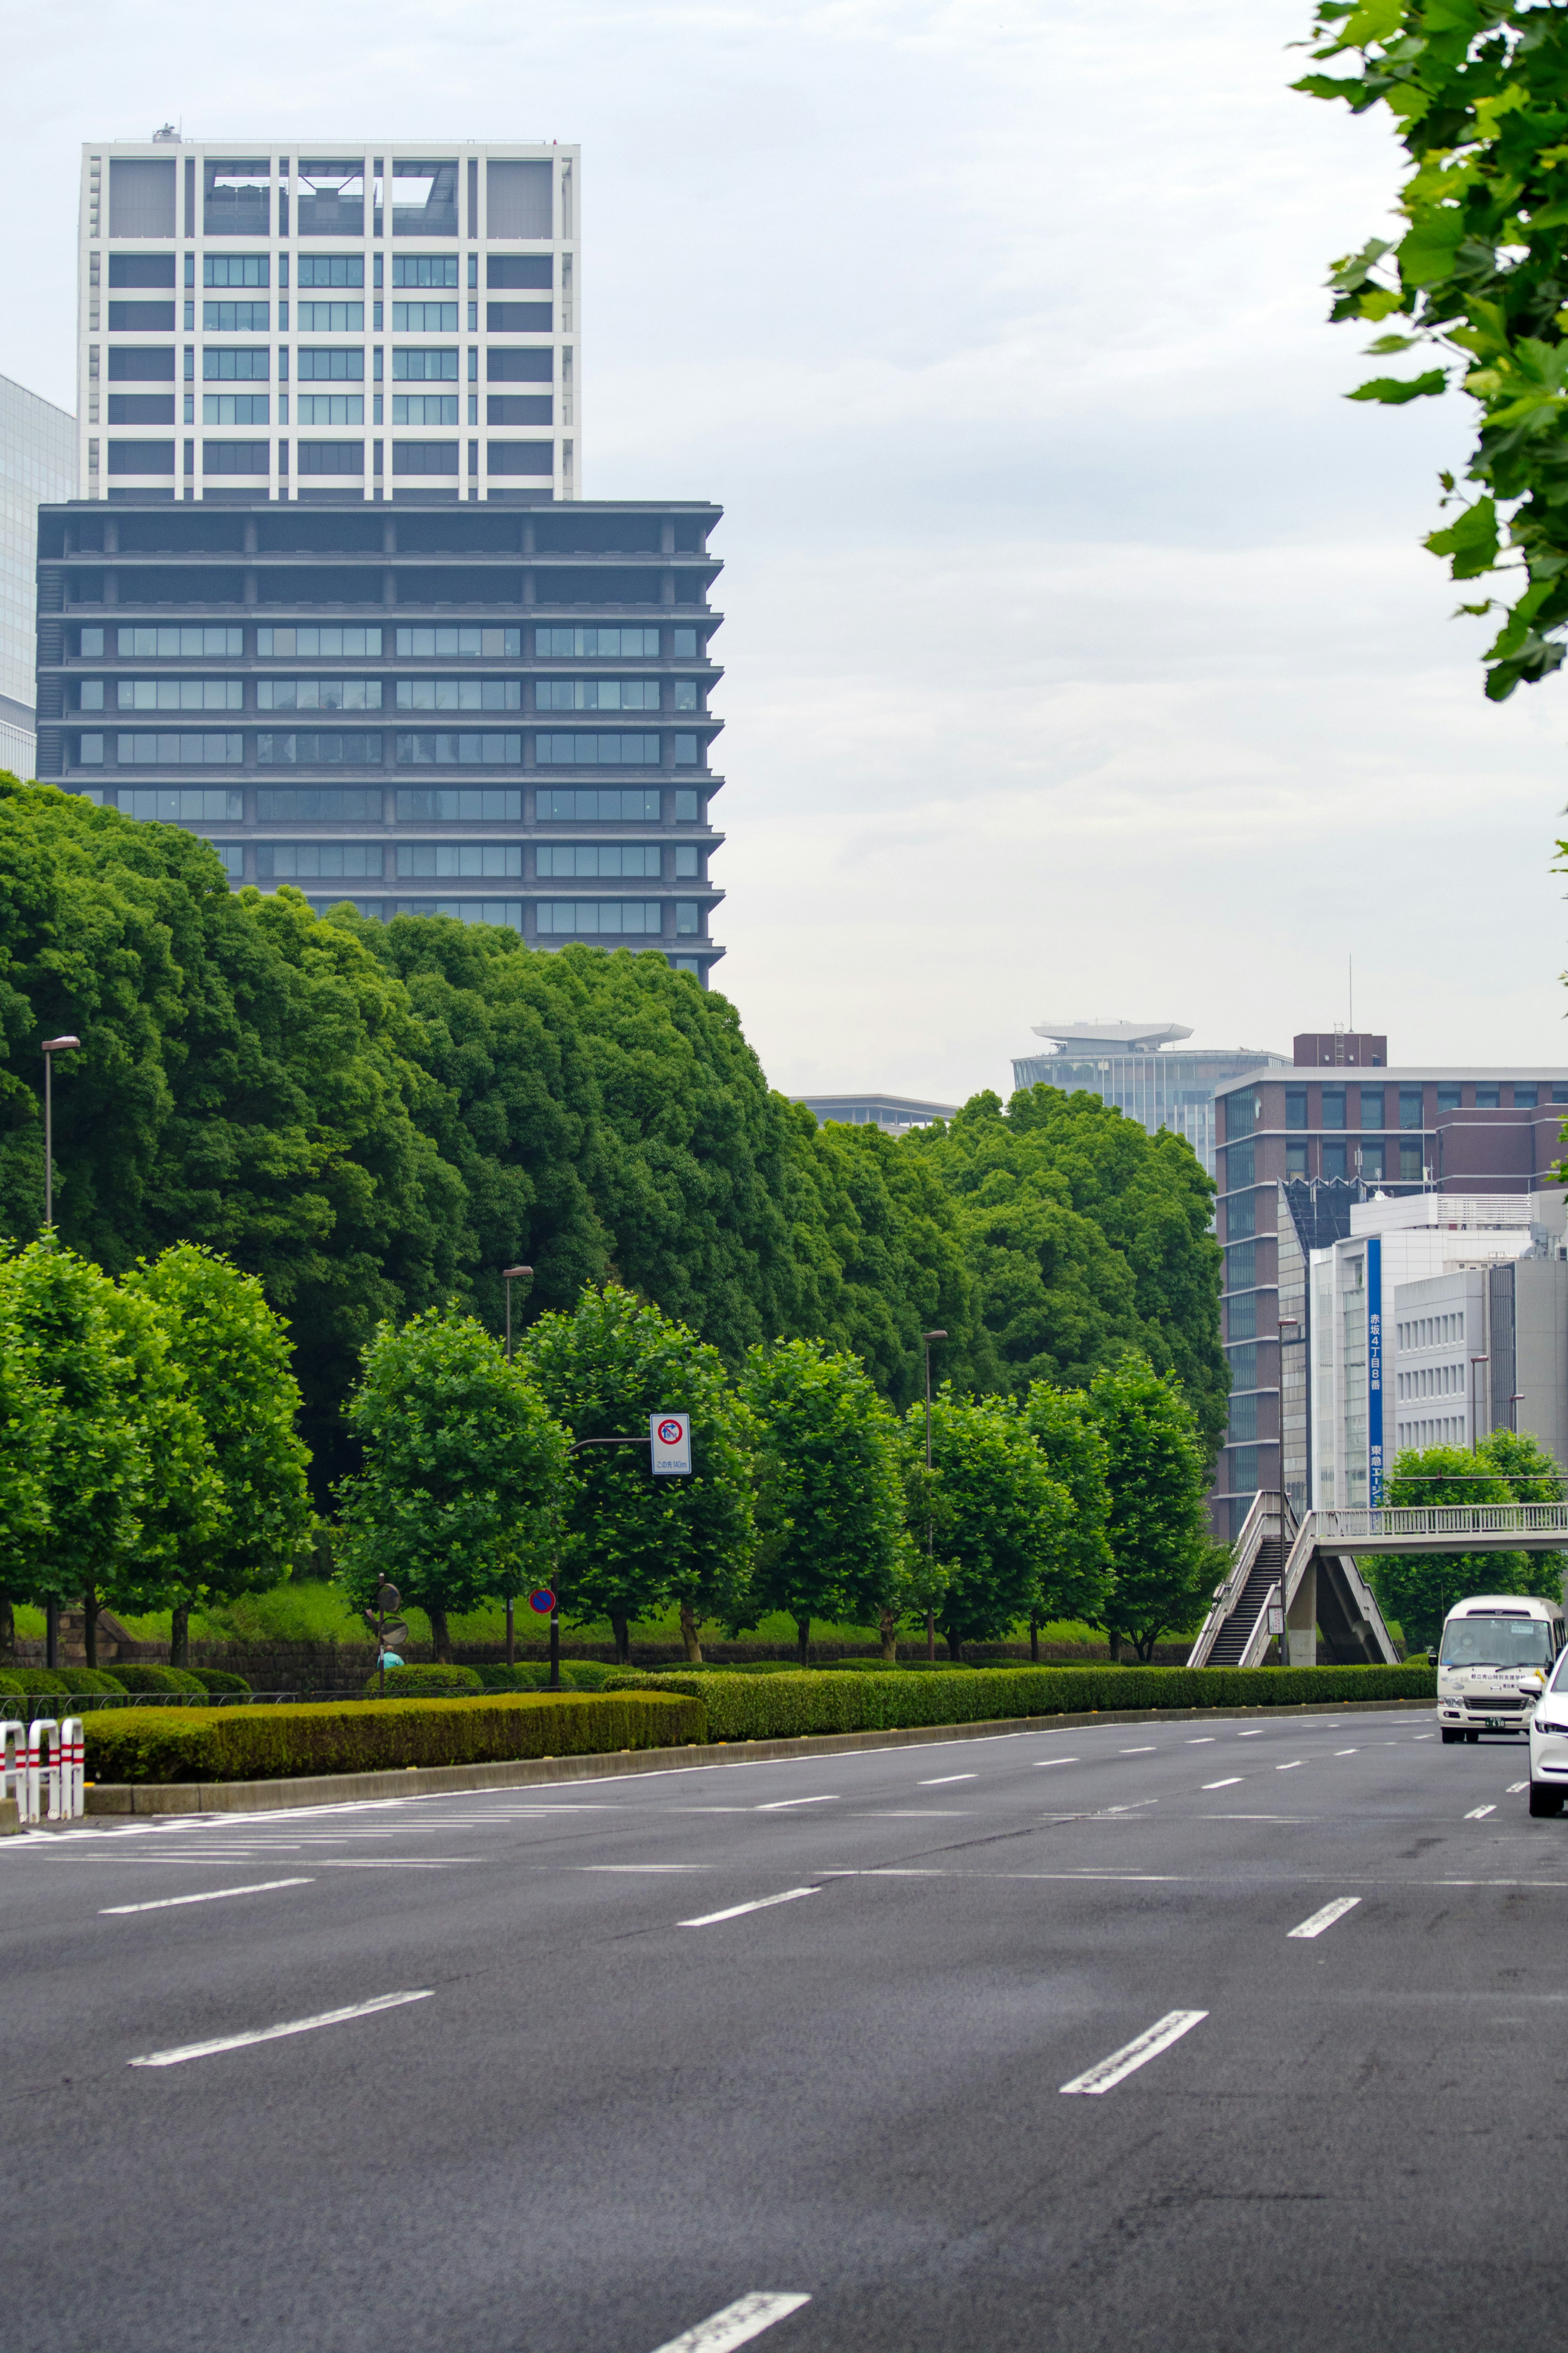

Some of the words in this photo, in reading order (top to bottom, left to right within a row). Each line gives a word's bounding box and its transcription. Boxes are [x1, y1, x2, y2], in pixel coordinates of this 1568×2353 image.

[1370, 1314, 1380, 1390] 赤坂4丁目8番
